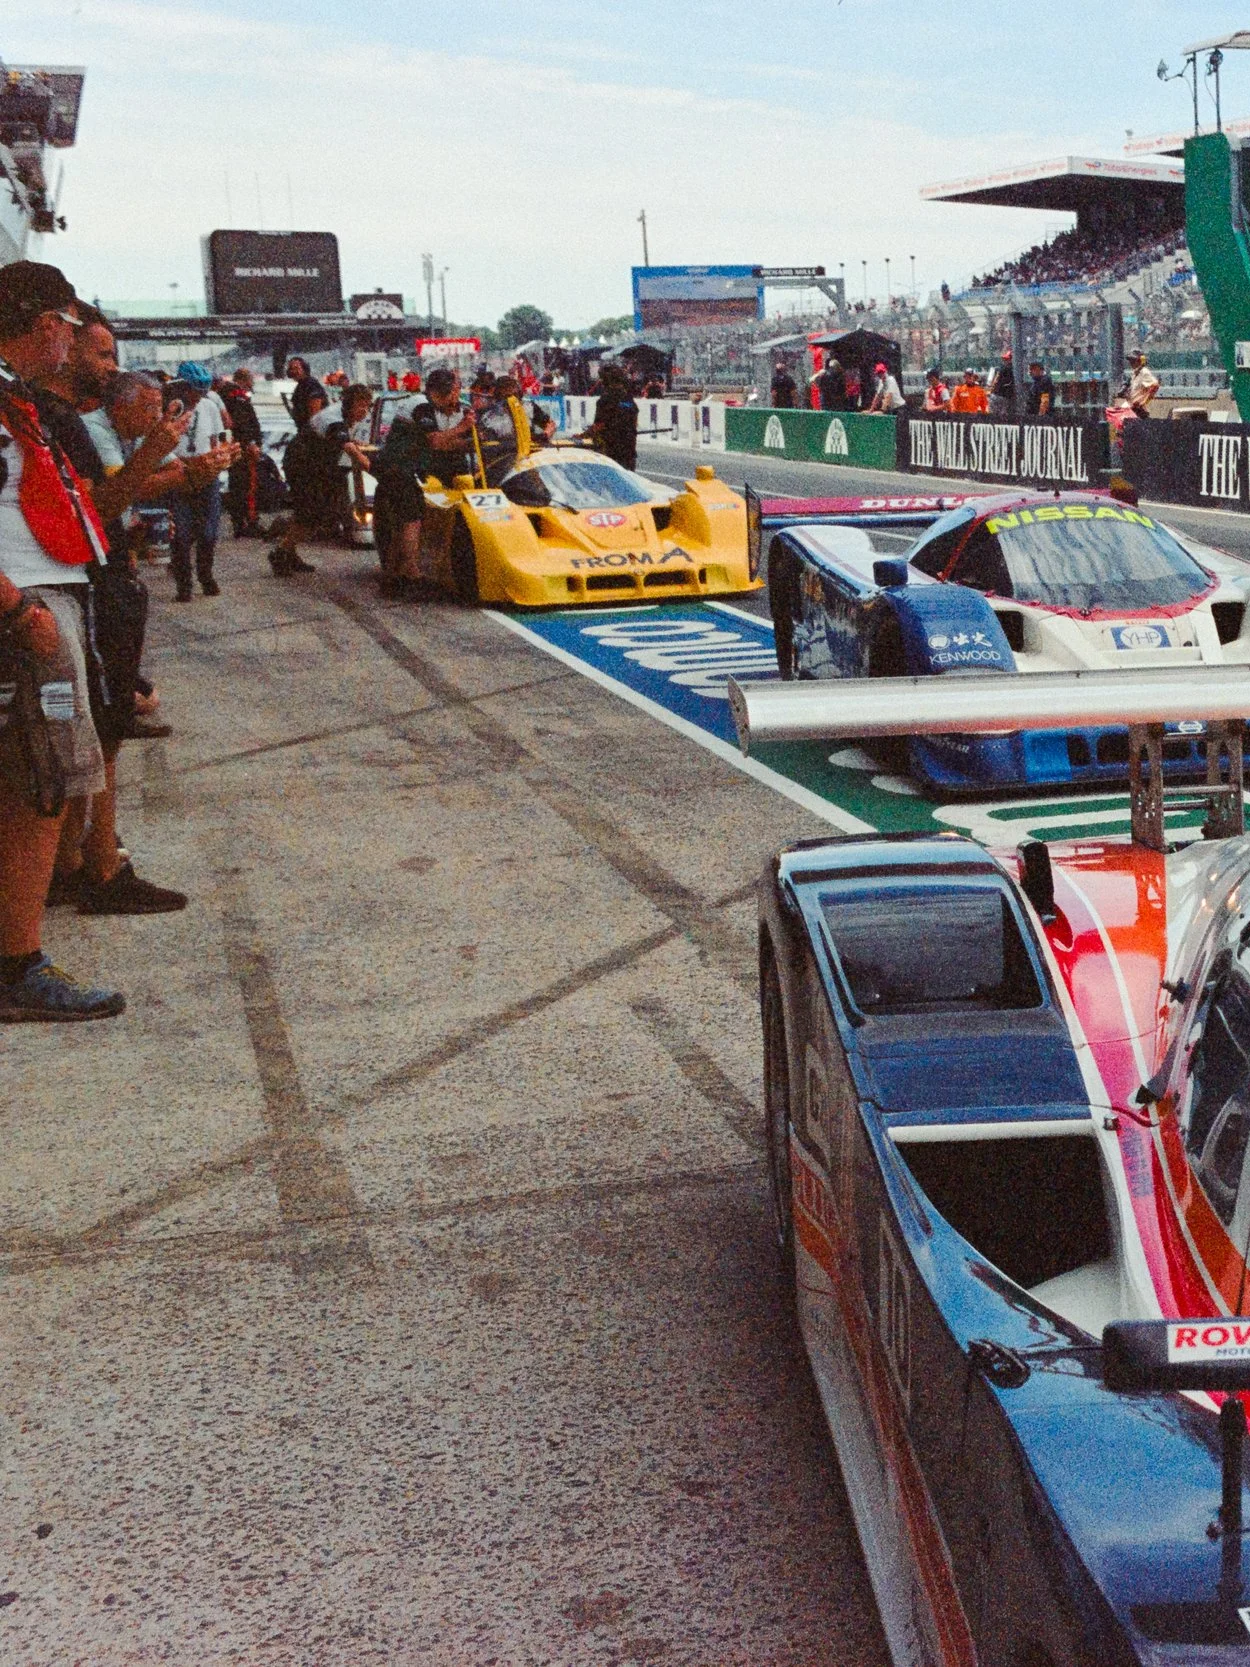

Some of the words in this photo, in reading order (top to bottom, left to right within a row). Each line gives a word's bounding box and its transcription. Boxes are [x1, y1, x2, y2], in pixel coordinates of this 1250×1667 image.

[908, 420, 934, 467] THE
[931, 422, 968, 471] WALL
[969, 422, 1019, 476] STREET
[1199, 434, 1241, 499] THE
[471, 495, 502, 506] 27
[588, 513, 624, 527] STP
[985, 505, 1157, 535] NISSAN
[1122, 631, 1160, 645] YHP
[929, 650, 1001, 665] KENWOOD
